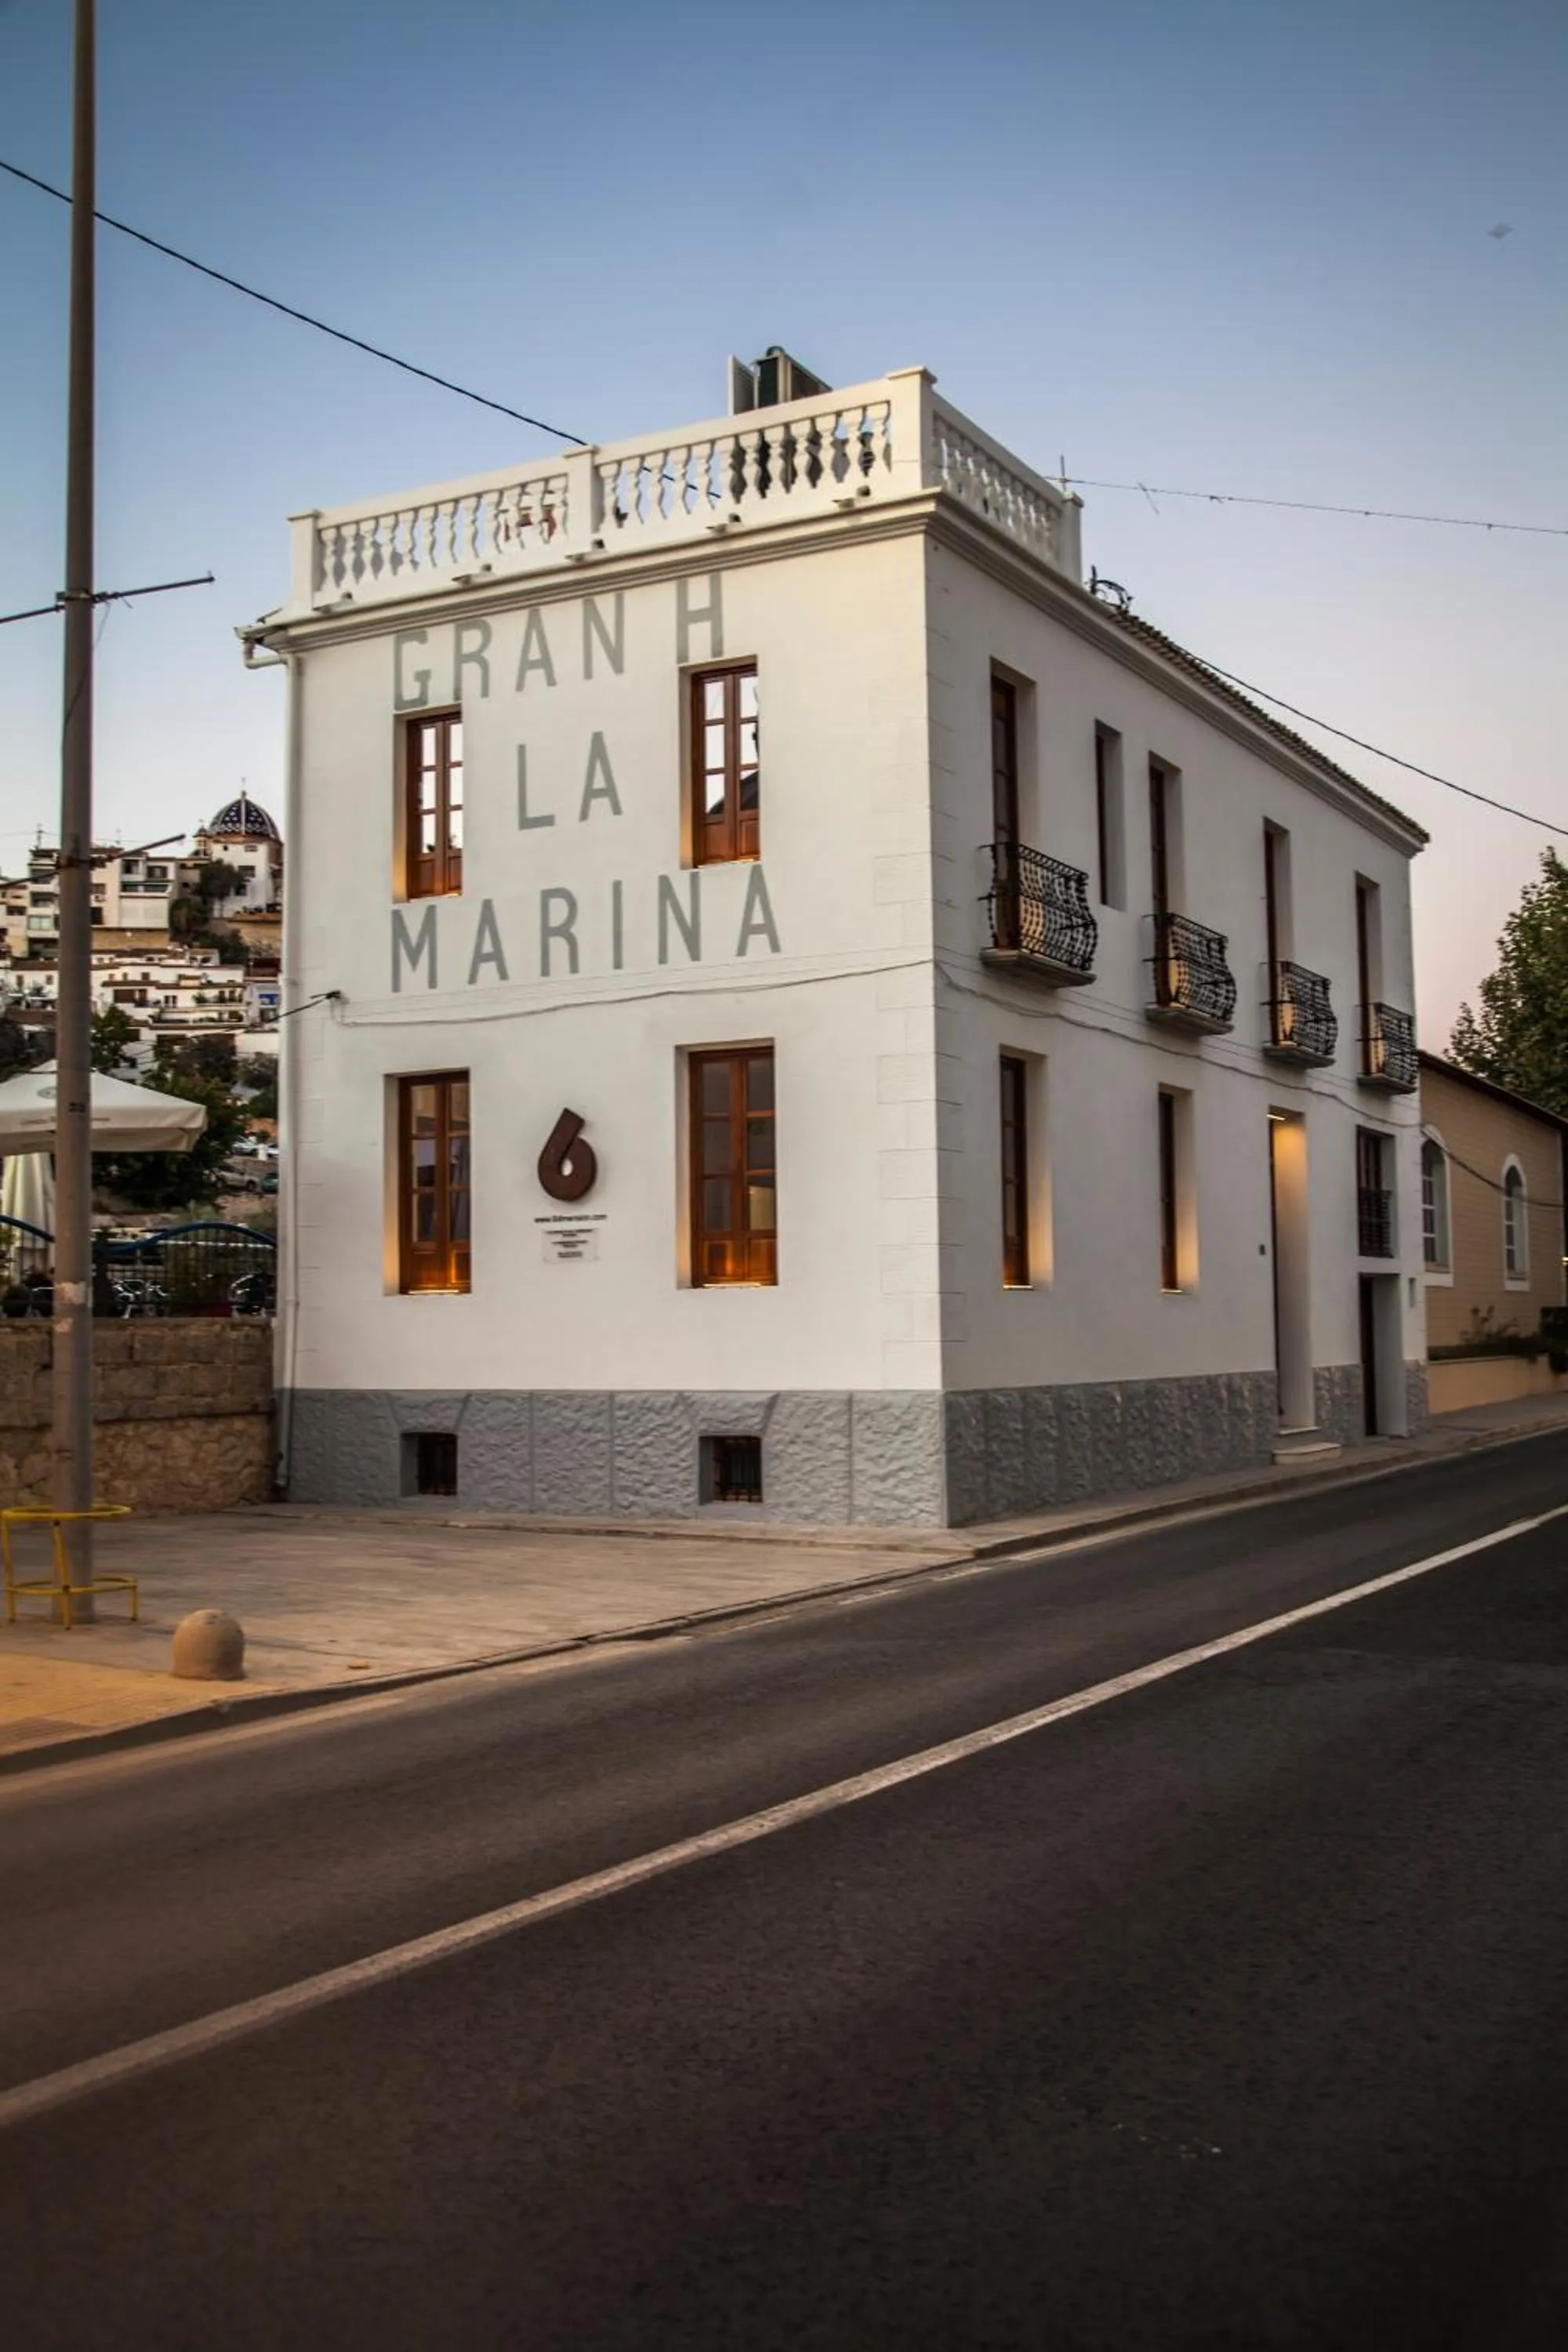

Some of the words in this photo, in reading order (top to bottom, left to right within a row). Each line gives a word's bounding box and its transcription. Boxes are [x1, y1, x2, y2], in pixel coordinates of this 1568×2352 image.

[394, 593, 625, 710] GRAN
[676, 571, 724, 663] H
[517, 731, 622, 830] LA
[391, 864, 782, 993] MARINA
